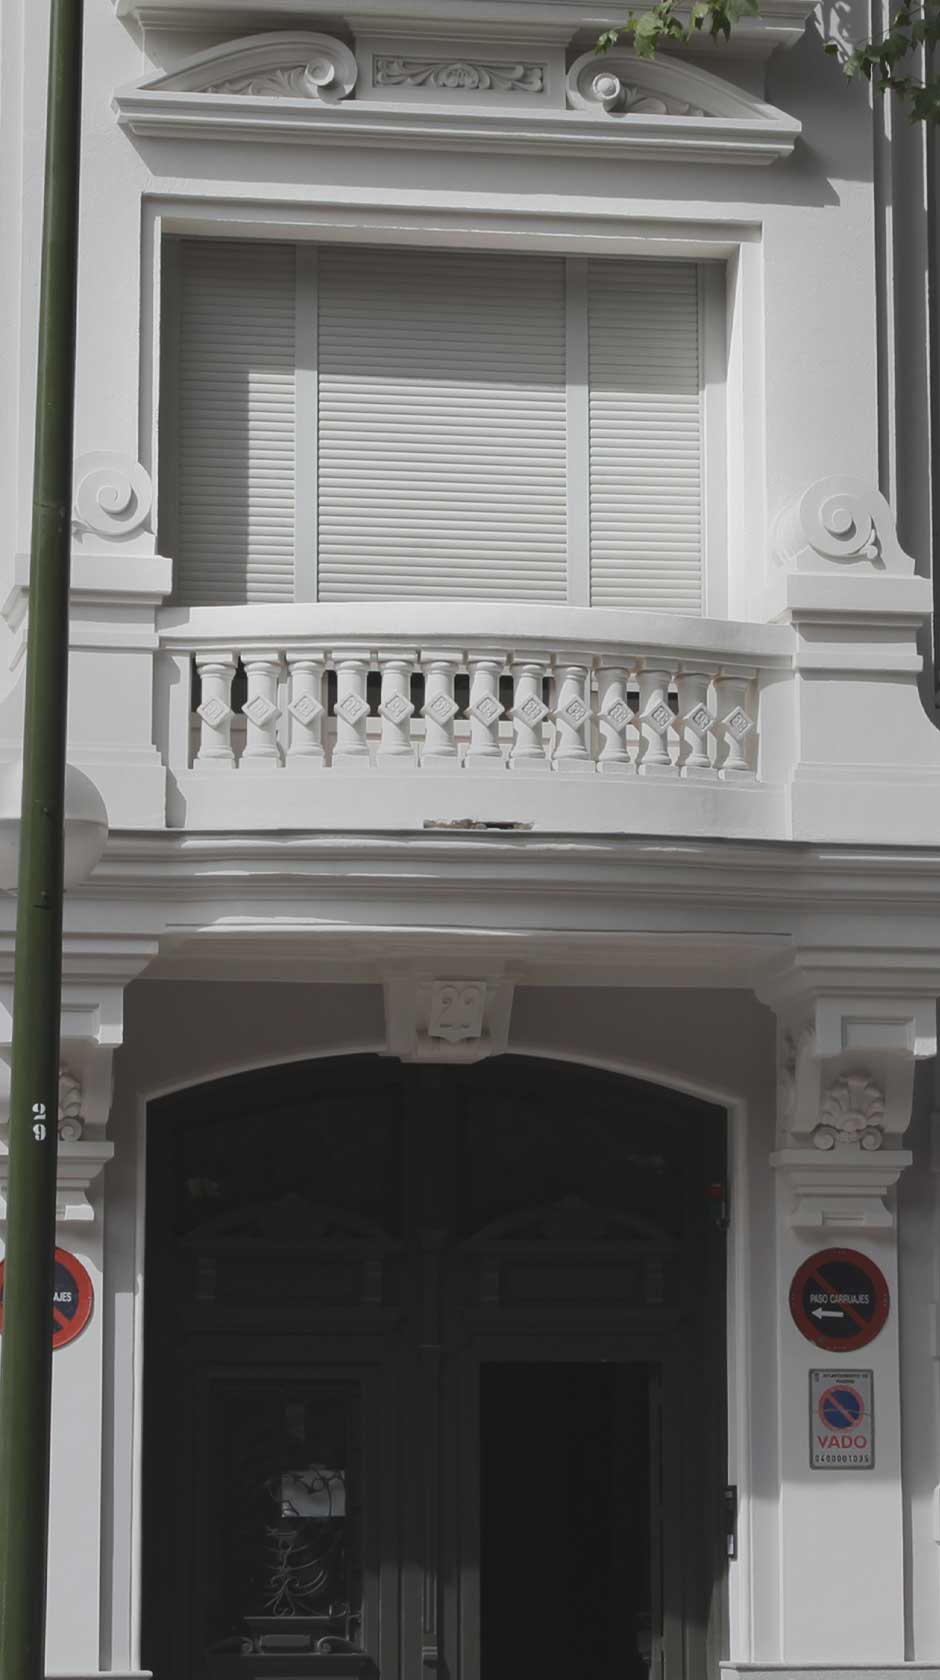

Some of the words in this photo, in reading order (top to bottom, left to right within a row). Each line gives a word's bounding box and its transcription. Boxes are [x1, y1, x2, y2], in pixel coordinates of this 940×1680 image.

[53, 1291, 72, 1302] AJES
[810, 1294, 828, 1304] PASO
[830, 1294, 870, 1304] CARRUAJES
[817, 1435, 867, 1449] VADO
